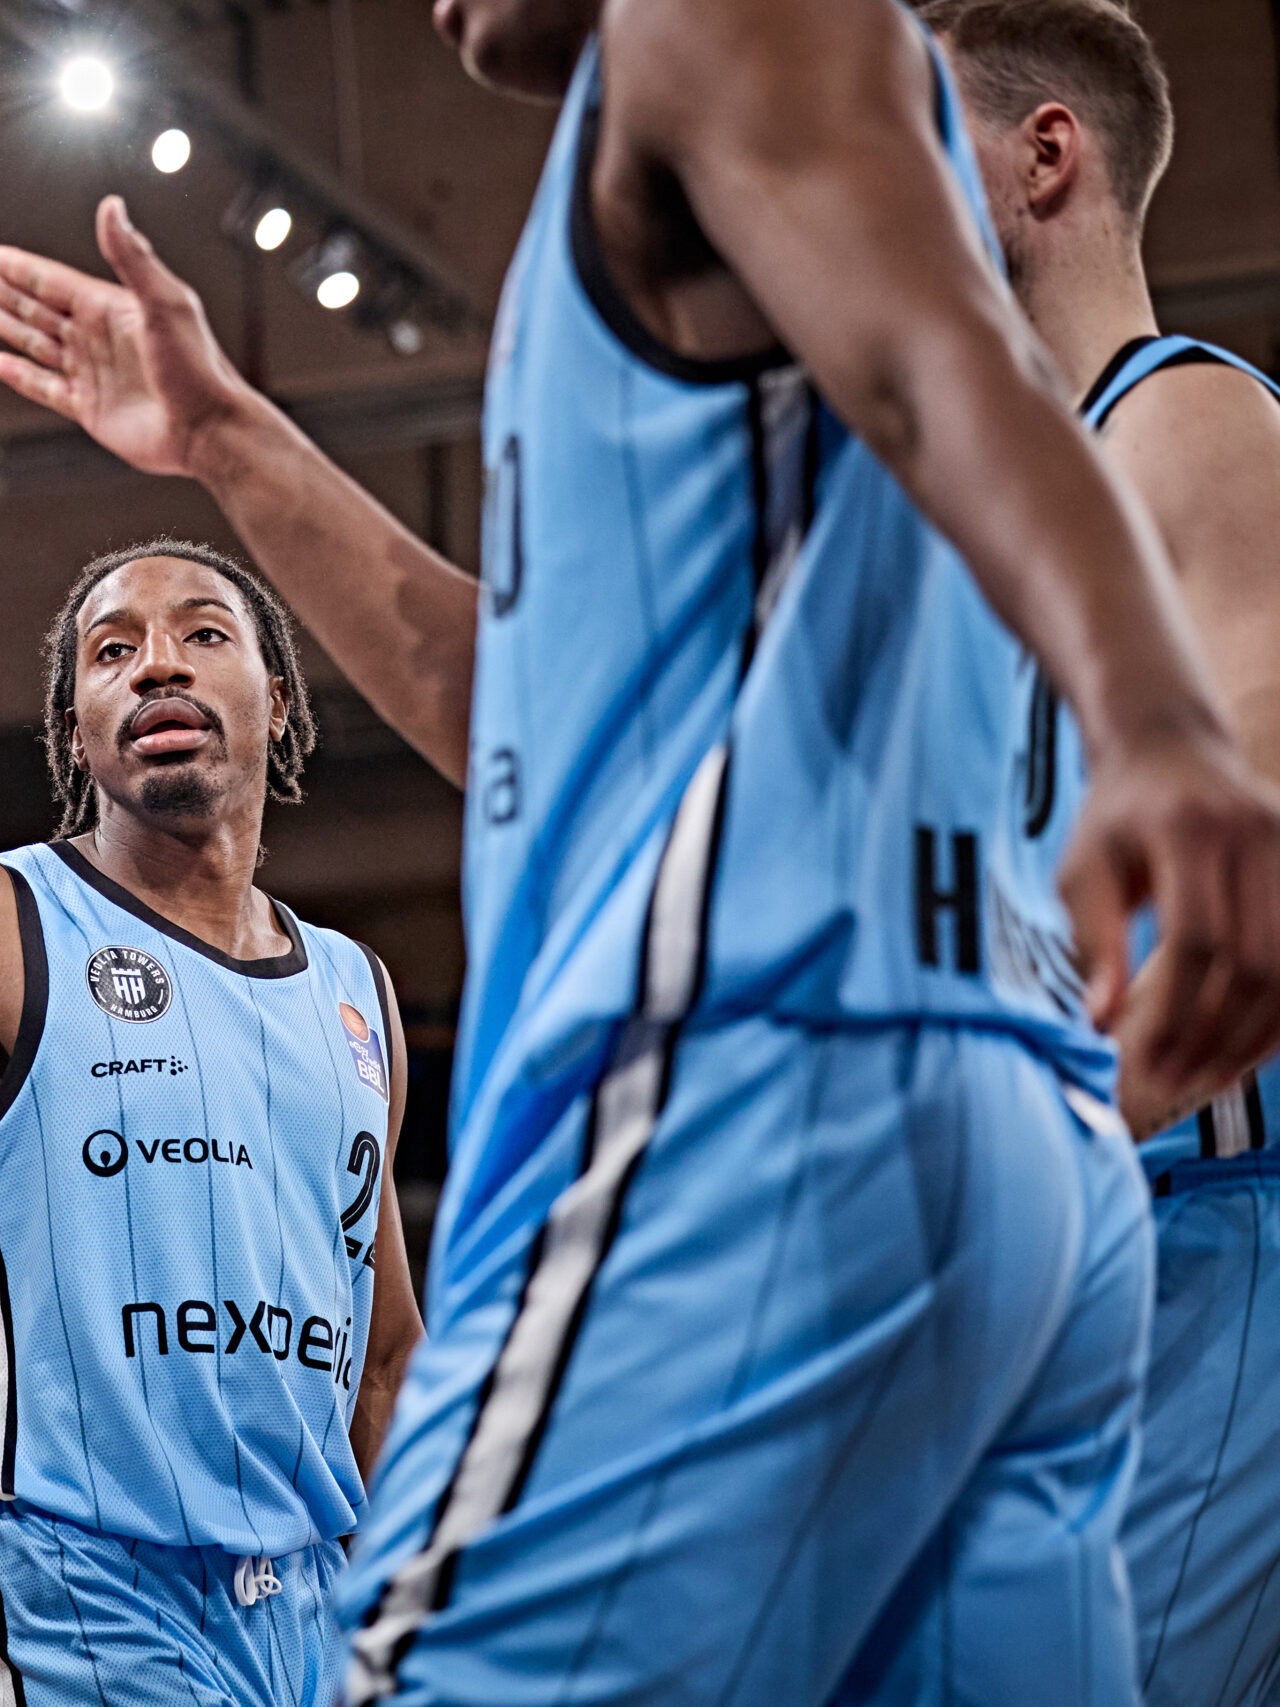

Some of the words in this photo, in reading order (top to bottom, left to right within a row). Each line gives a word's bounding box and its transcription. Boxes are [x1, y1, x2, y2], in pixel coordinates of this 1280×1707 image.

[90, 950, 118, 983] VEOLIA
[122, 950, 165, 985] TOWERS
[110, 1003, 158, 1019] HAMBURG
[91, 1059, 167, 1078] CRAFT
[357, 1059, 385, 1094] BBL
[136, 1137, 253, 1170] VEOLIA
